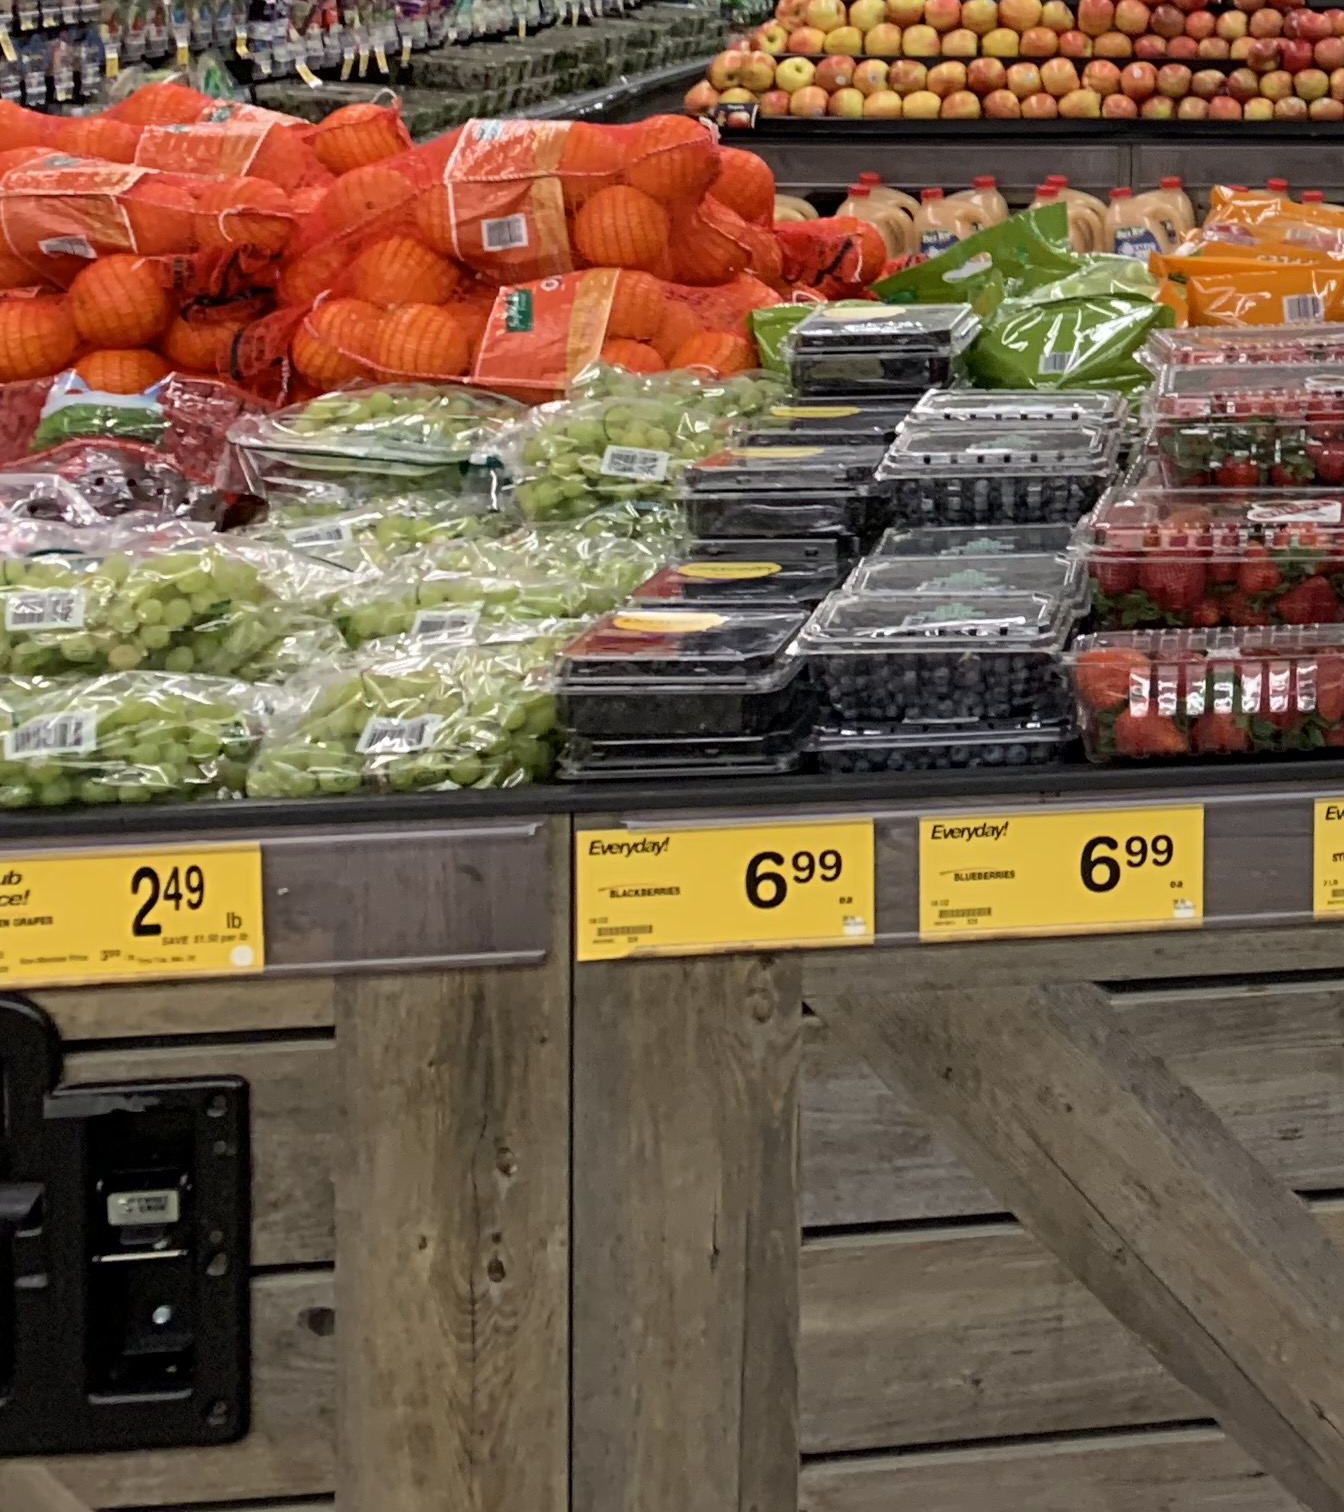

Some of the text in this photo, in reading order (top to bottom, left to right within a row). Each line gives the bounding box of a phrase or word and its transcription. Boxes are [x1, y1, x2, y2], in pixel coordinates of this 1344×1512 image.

[931, 821, 1009, 842] Everyday!
[588, 837, 670, 857] Everyday!
[954, 869, 1015, 882] BLUEBERRIES
[609, 886, 680, 899] BLACKBERRIES
[226, 912, 242, 929] lb
[162, 935, 189, 946] SAVE
[220, 934, 236, 944] per
